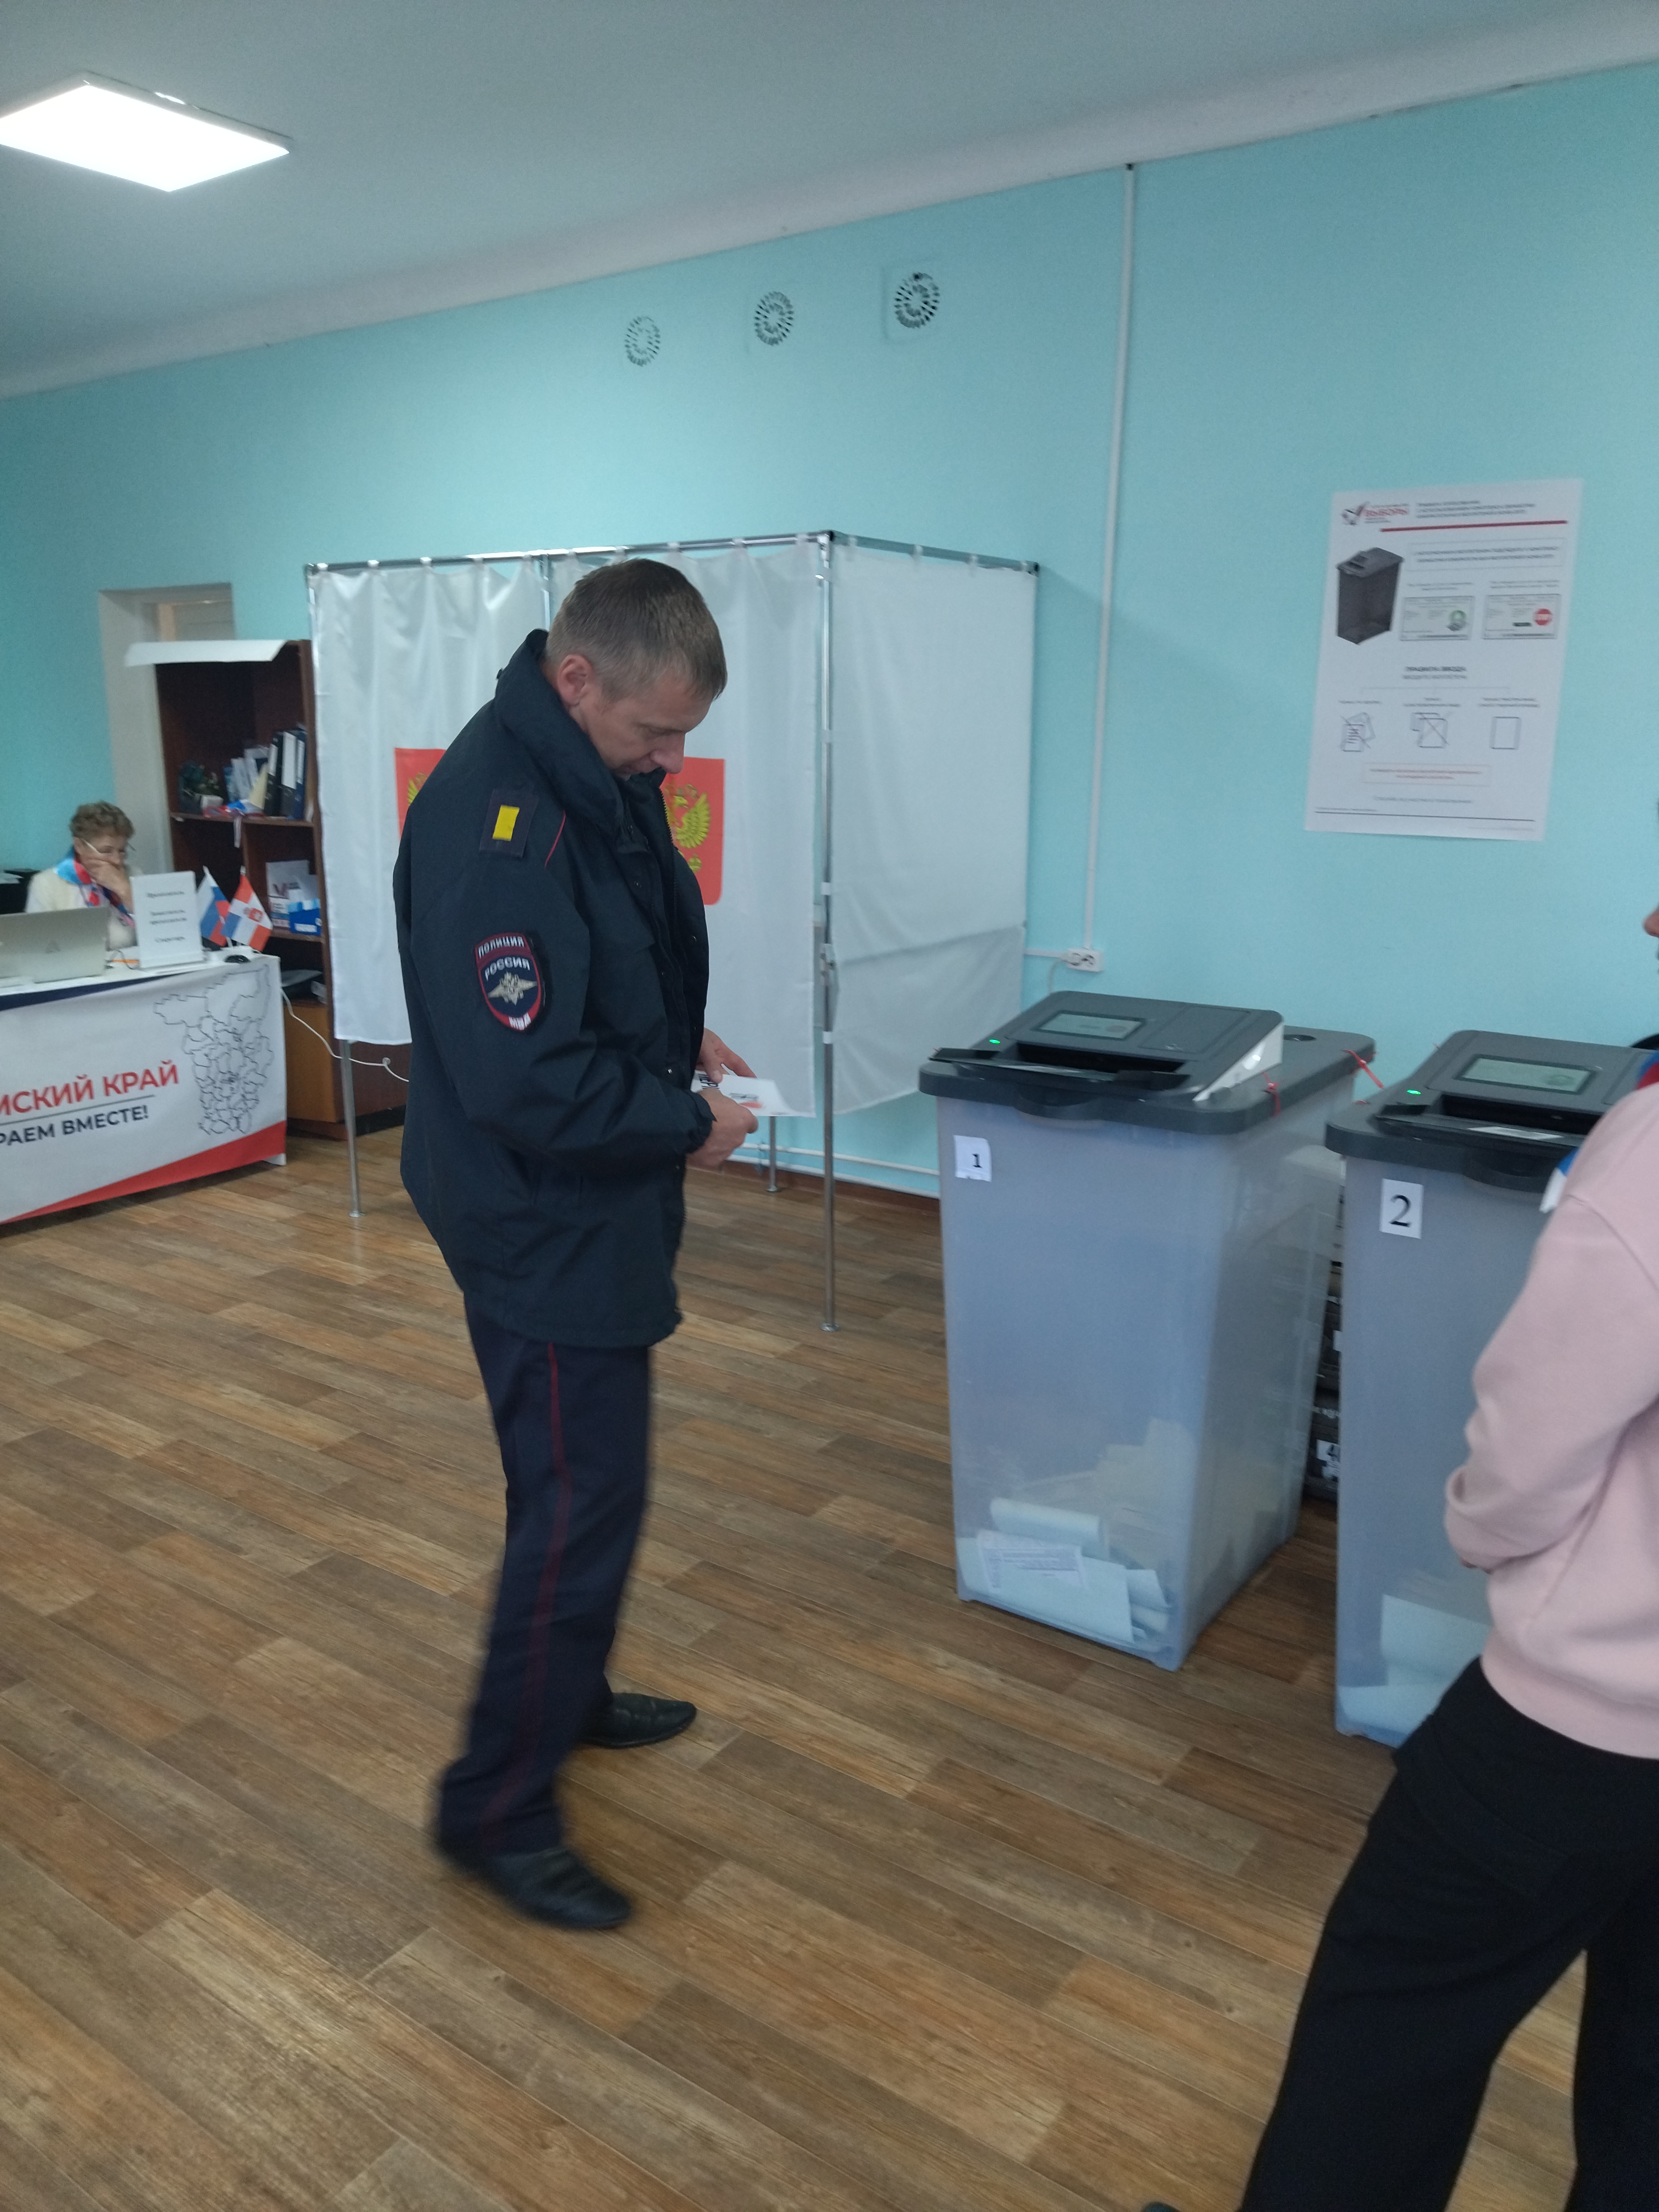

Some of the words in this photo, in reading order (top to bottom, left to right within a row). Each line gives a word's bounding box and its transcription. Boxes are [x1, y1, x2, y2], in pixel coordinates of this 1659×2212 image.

[477, 936, 525, 959] ПОЛИЦИЯ
[484, 956, 530, 981] РОССИЯ
[102, 1059, 179, 1097] КРАЙ
[62, 1105, 149, 1135] ВМЕСТЕ!
[972, 1153, 982, 1168] 1
[1389, 1194, 1412, 1227] 2
